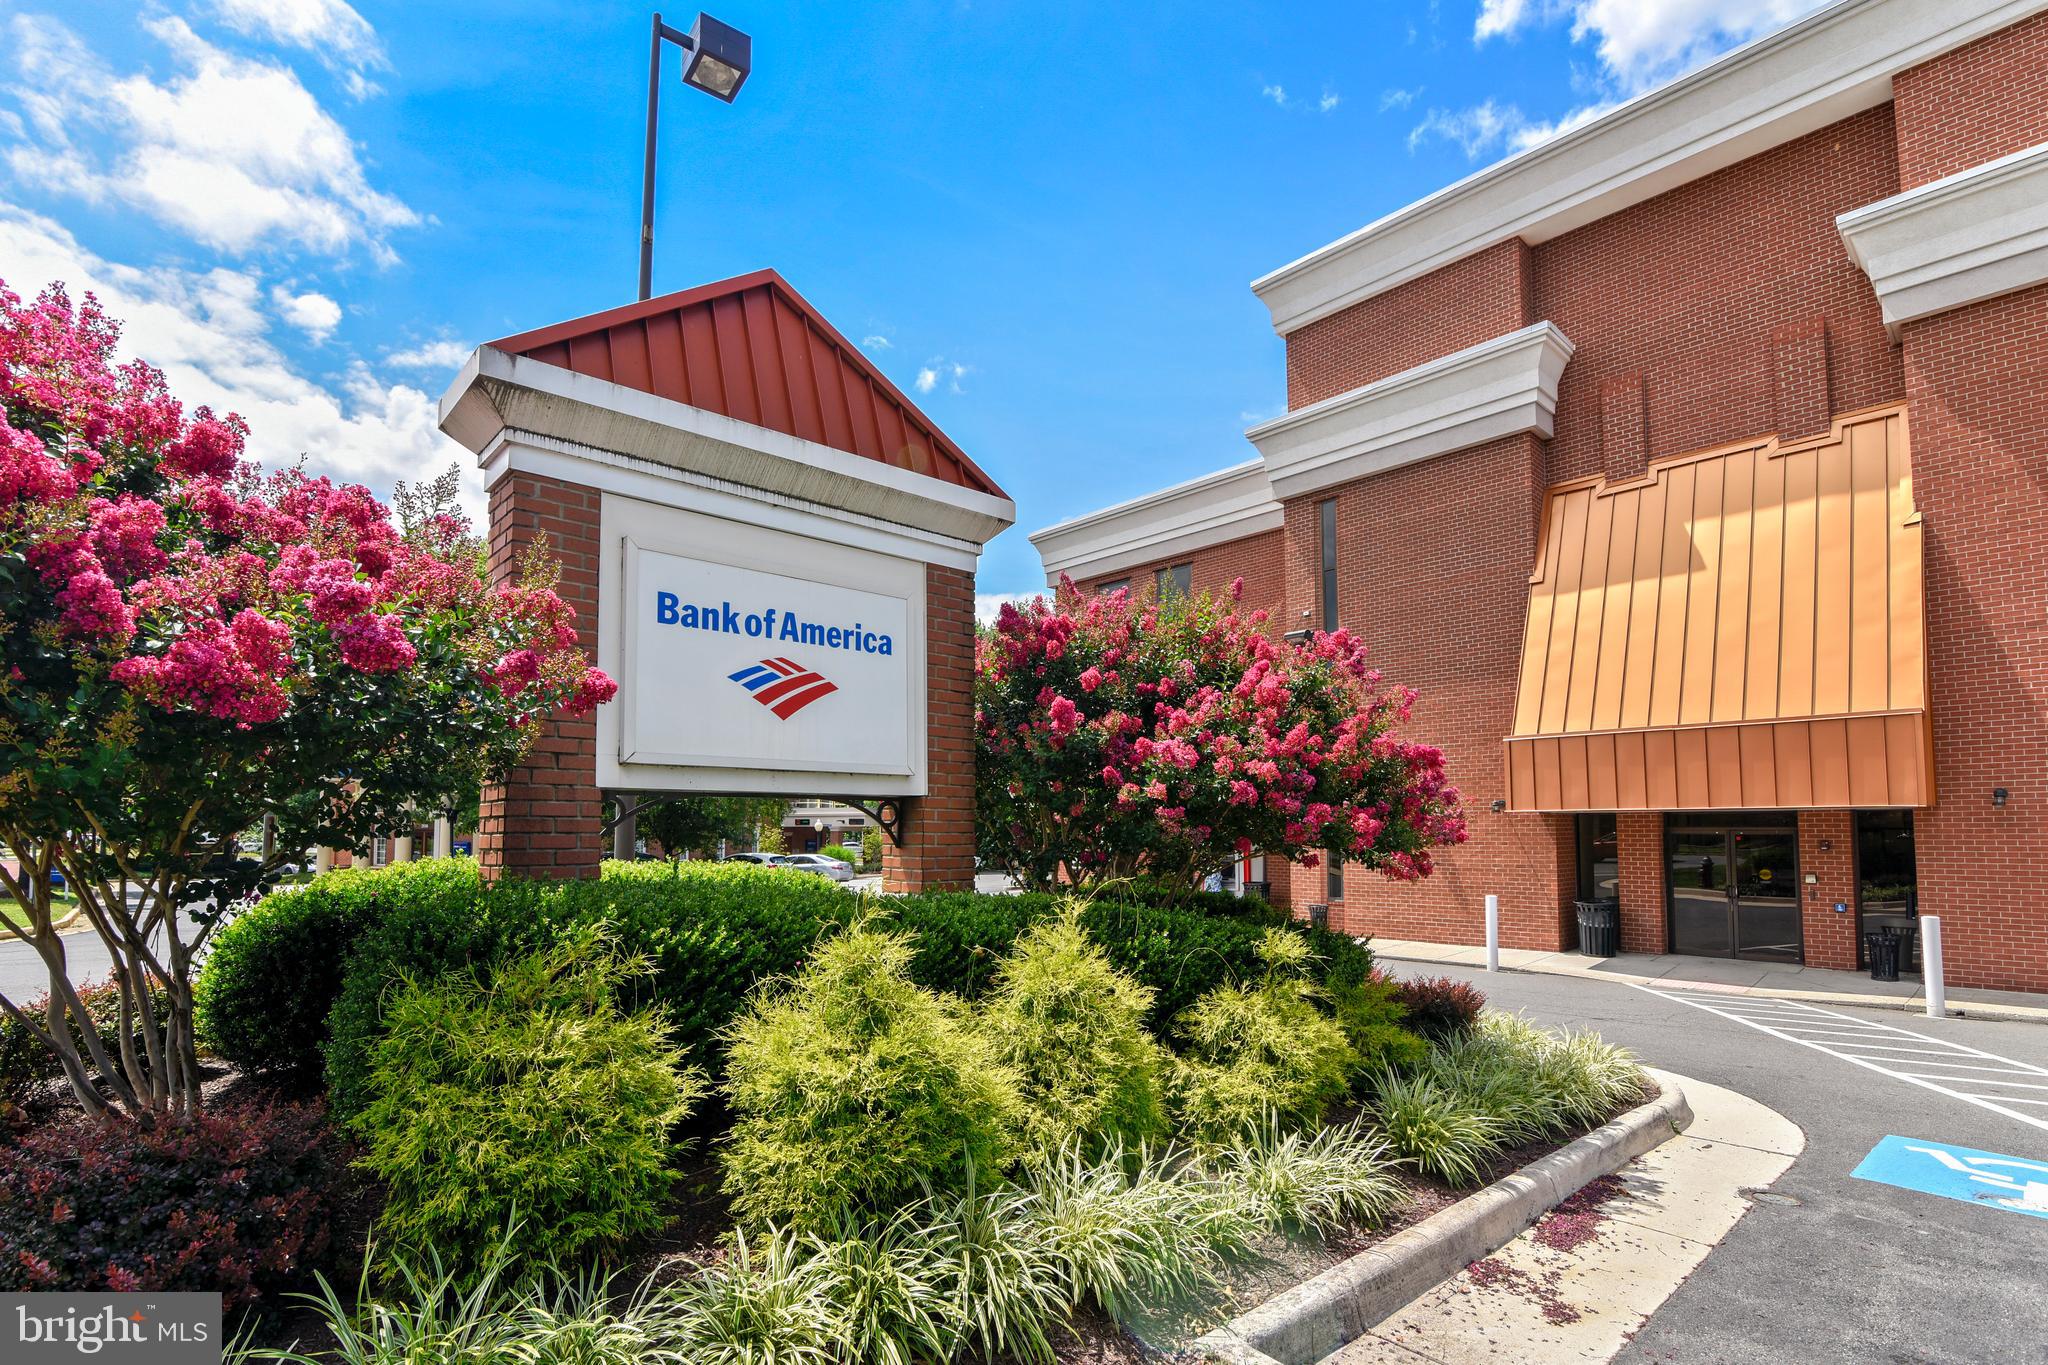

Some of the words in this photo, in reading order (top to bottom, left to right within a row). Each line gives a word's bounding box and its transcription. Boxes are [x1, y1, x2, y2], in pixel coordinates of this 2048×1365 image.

[657, 591, 740, 635] Bank
[744, 608, 777, 639] of
[780, 611, 893, 656] America
